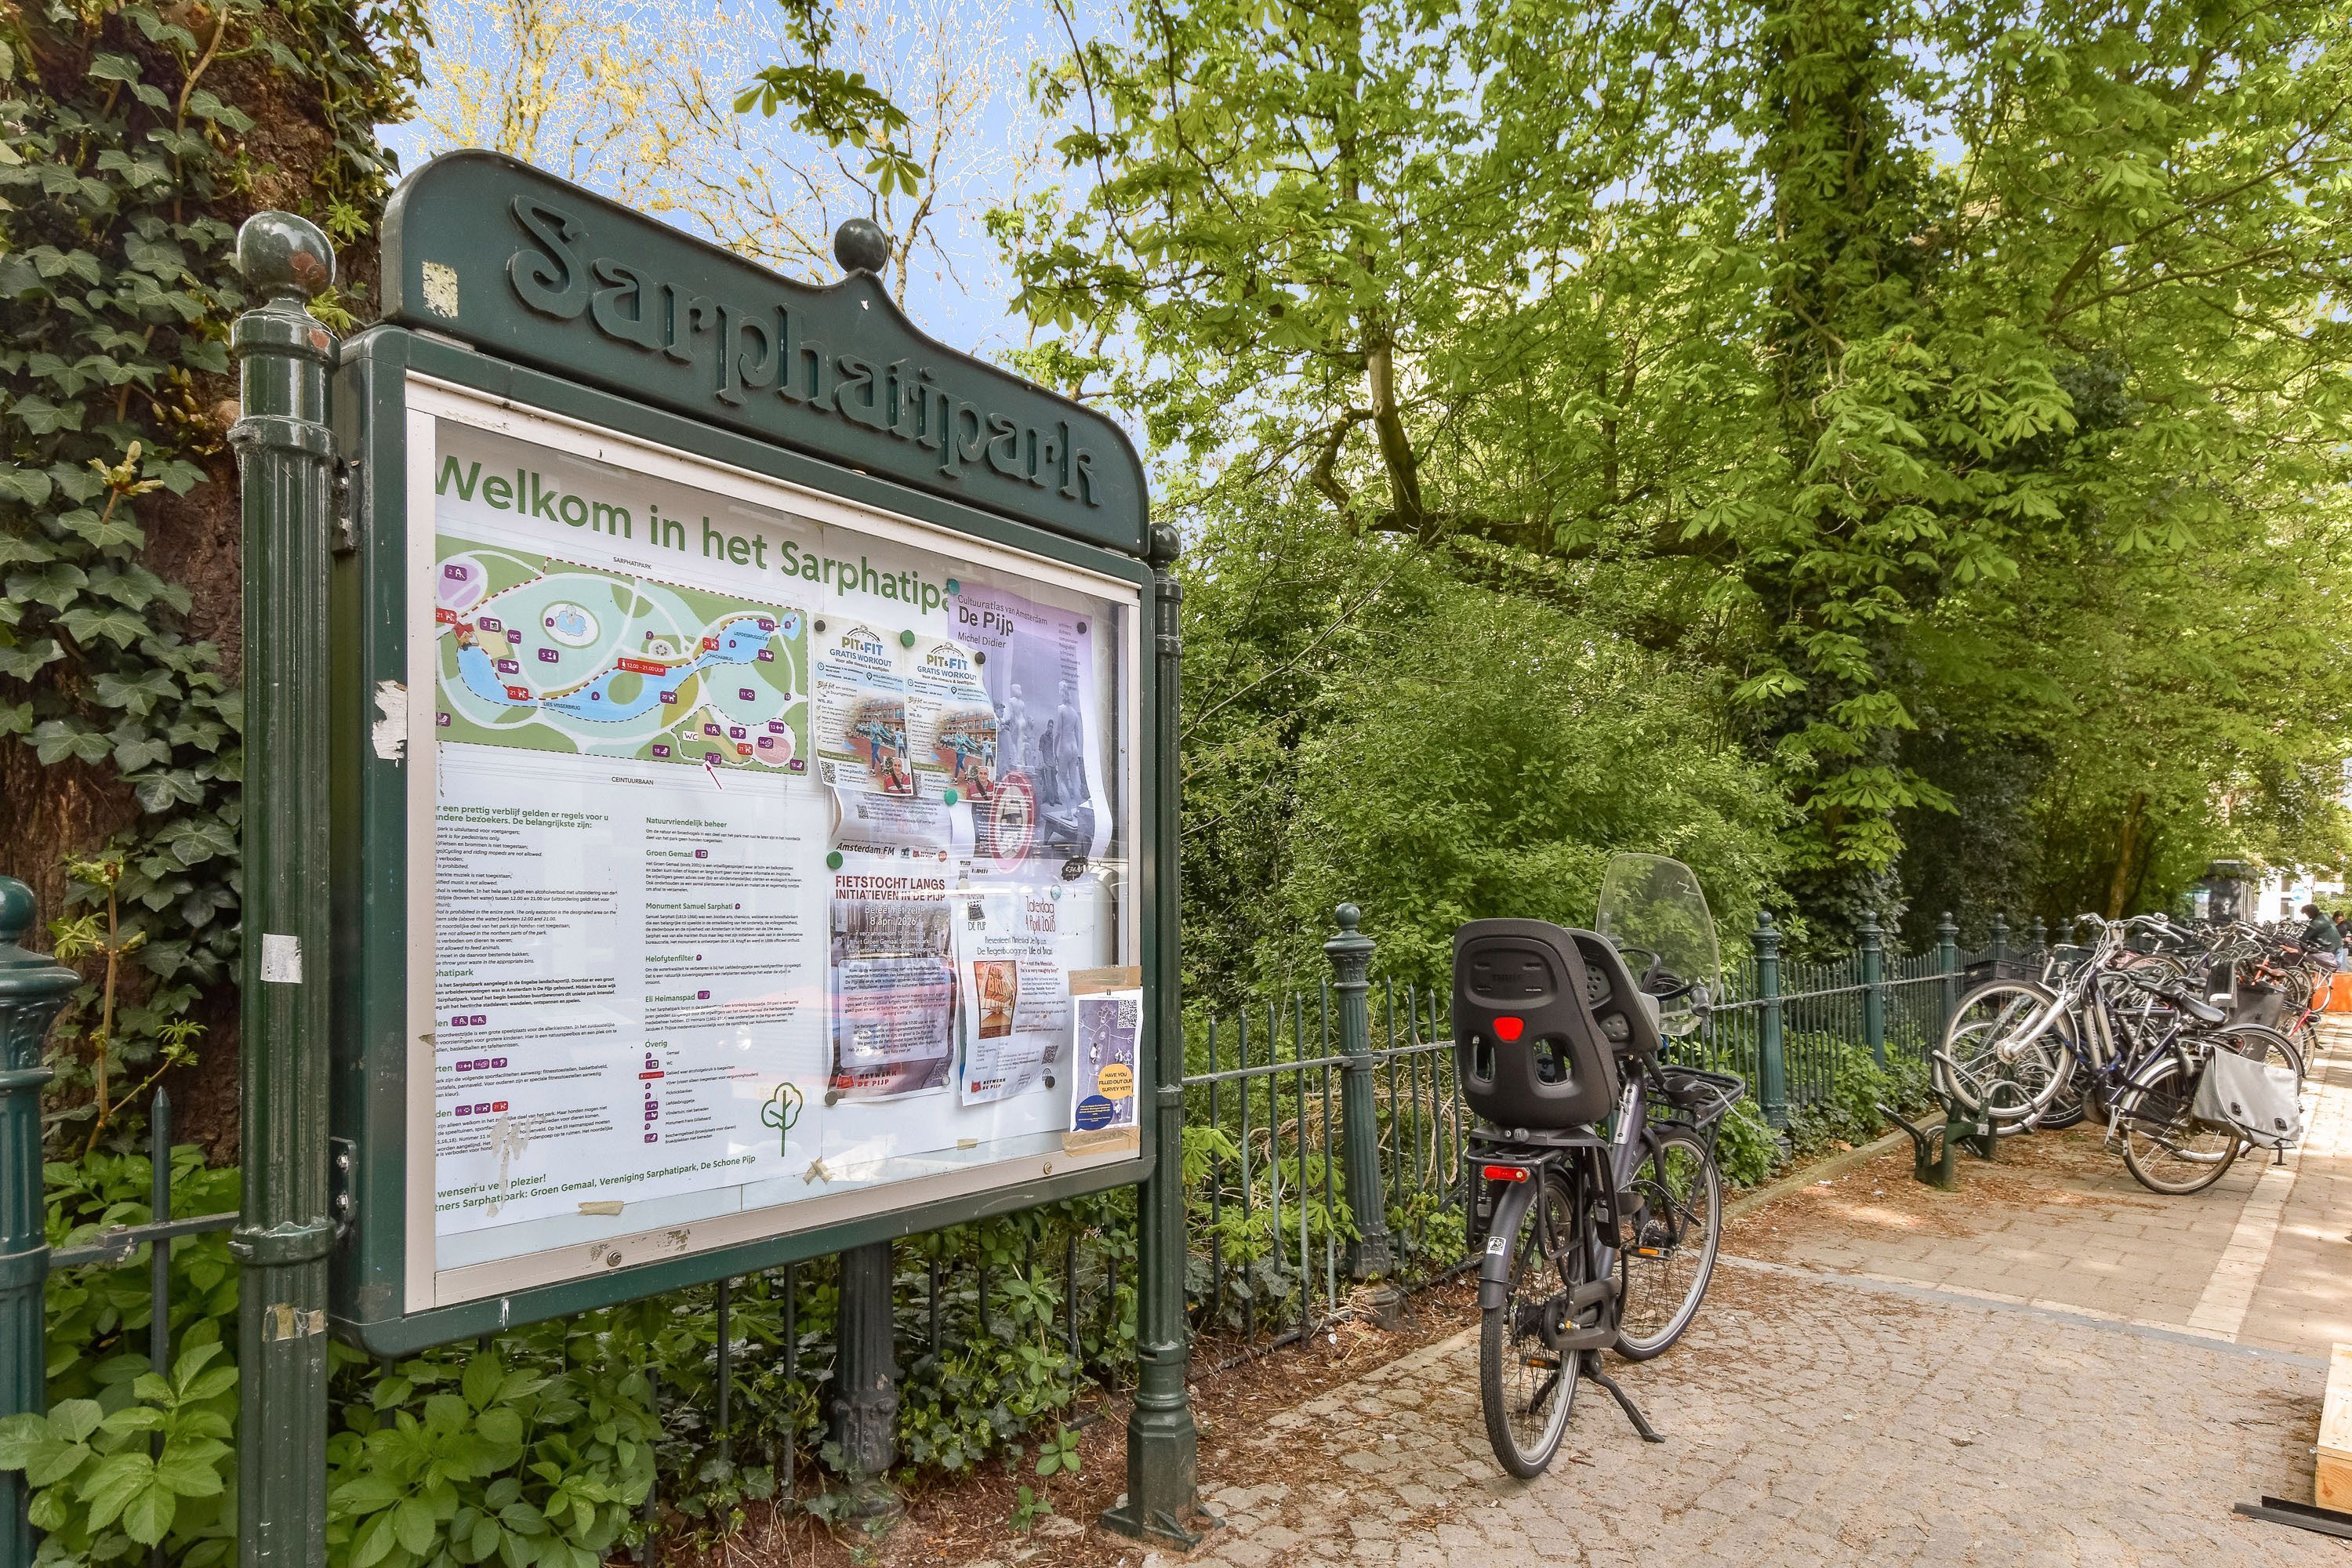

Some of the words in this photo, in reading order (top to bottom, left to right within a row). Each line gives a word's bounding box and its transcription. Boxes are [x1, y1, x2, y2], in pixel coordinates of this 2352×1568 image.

[510, 196, 1100, 508] Sarphatipark
[436, 455, 632, 539] Welkom
[651, 504, 686, 553] in
[703, 516, 768, 571] het
[613, 557, 652, 569] SARPHATIPARK
[957, 594, 1004, 612] Cultuuratlas
[1005, 606, 1015, 615] van
[1015, 608, 1048, 626] Amsterdam
[959, 606, 978, 626] De
[982, 611, 1014, 636] Pijp
[841, 636, 884, 656] PIT&FIT
[957, 631, 979, 644] Michel
[982, 637, 1007, 648] Didier
[829, 648, 856, 659] GRATIS
[857, 654, 892, 667] WORKOUT
[927, 653, 967, 670] PIT&FIT
[916, 666, 941, 676] GRATIS
[942, 670, 977, 681] WORKOUT
[684, 731, 698, 741] WC
[612, 776, 654, 785] CEINTUURBAAN
[461, 805, 490, 815] prettig
[492, 808, 521, 817] verblijf
[522, 809, 550, 818] gelden
[561, 811, 584, 821] regels
[466, 815, 511, 824] bezoekers.
[525, 818, 575, 828] belangrijkste
[577, 820, 593, 829] zijn:
[645, 817, 703, 828] Natuurvriendelijk
[704, 819, 728, 828] beheer
[835, 875, 908, 889] FIETSTOCHT
[909, 877, 946, 891] LANGS
[835, 889, 898, 901] INITIATIEVEN
[902, 891, 910, 901] IN
[913, 891, 925, 902] DE
[927, 892, 946, 902] PIJP
[707, 902, 733, 912] Sarphati
[865, 904, 891, 915] Beleef
[892, 906, 906, 915] het
[907, 905, 924, 915] zelf!
[869, 917, 876, 926] 8
[877, 916, 896, 927] april
[898, 916, 917, 926] 2026
[645, 955, 694, 964] Helofytenfilter
[654, 993, 695, 1003] Heimanspad
[645, 1040, 668, 1049] Overig
[872, 1079, 890, 1087] PIJP
[437, 1185, 477, 1199] wensen
[487, 1179, 508, 1191] vel
[510, 1174, 546, 1189] plezier!
[463, 1190, 528, 1210] Sarphatipark:
[530, 1186, 559, 1197] Groen
[561, 1180, 597, 1192] Gemaal,
[599, 1171, 645, 1185] Vereniging
[646, 1163, 699, 1181] Sarphatipark,
[700, 1161, 711, 1170] De
[713, 1158, 741, 1169] Schone
[742, 1155, 757, 1165] Pijp
